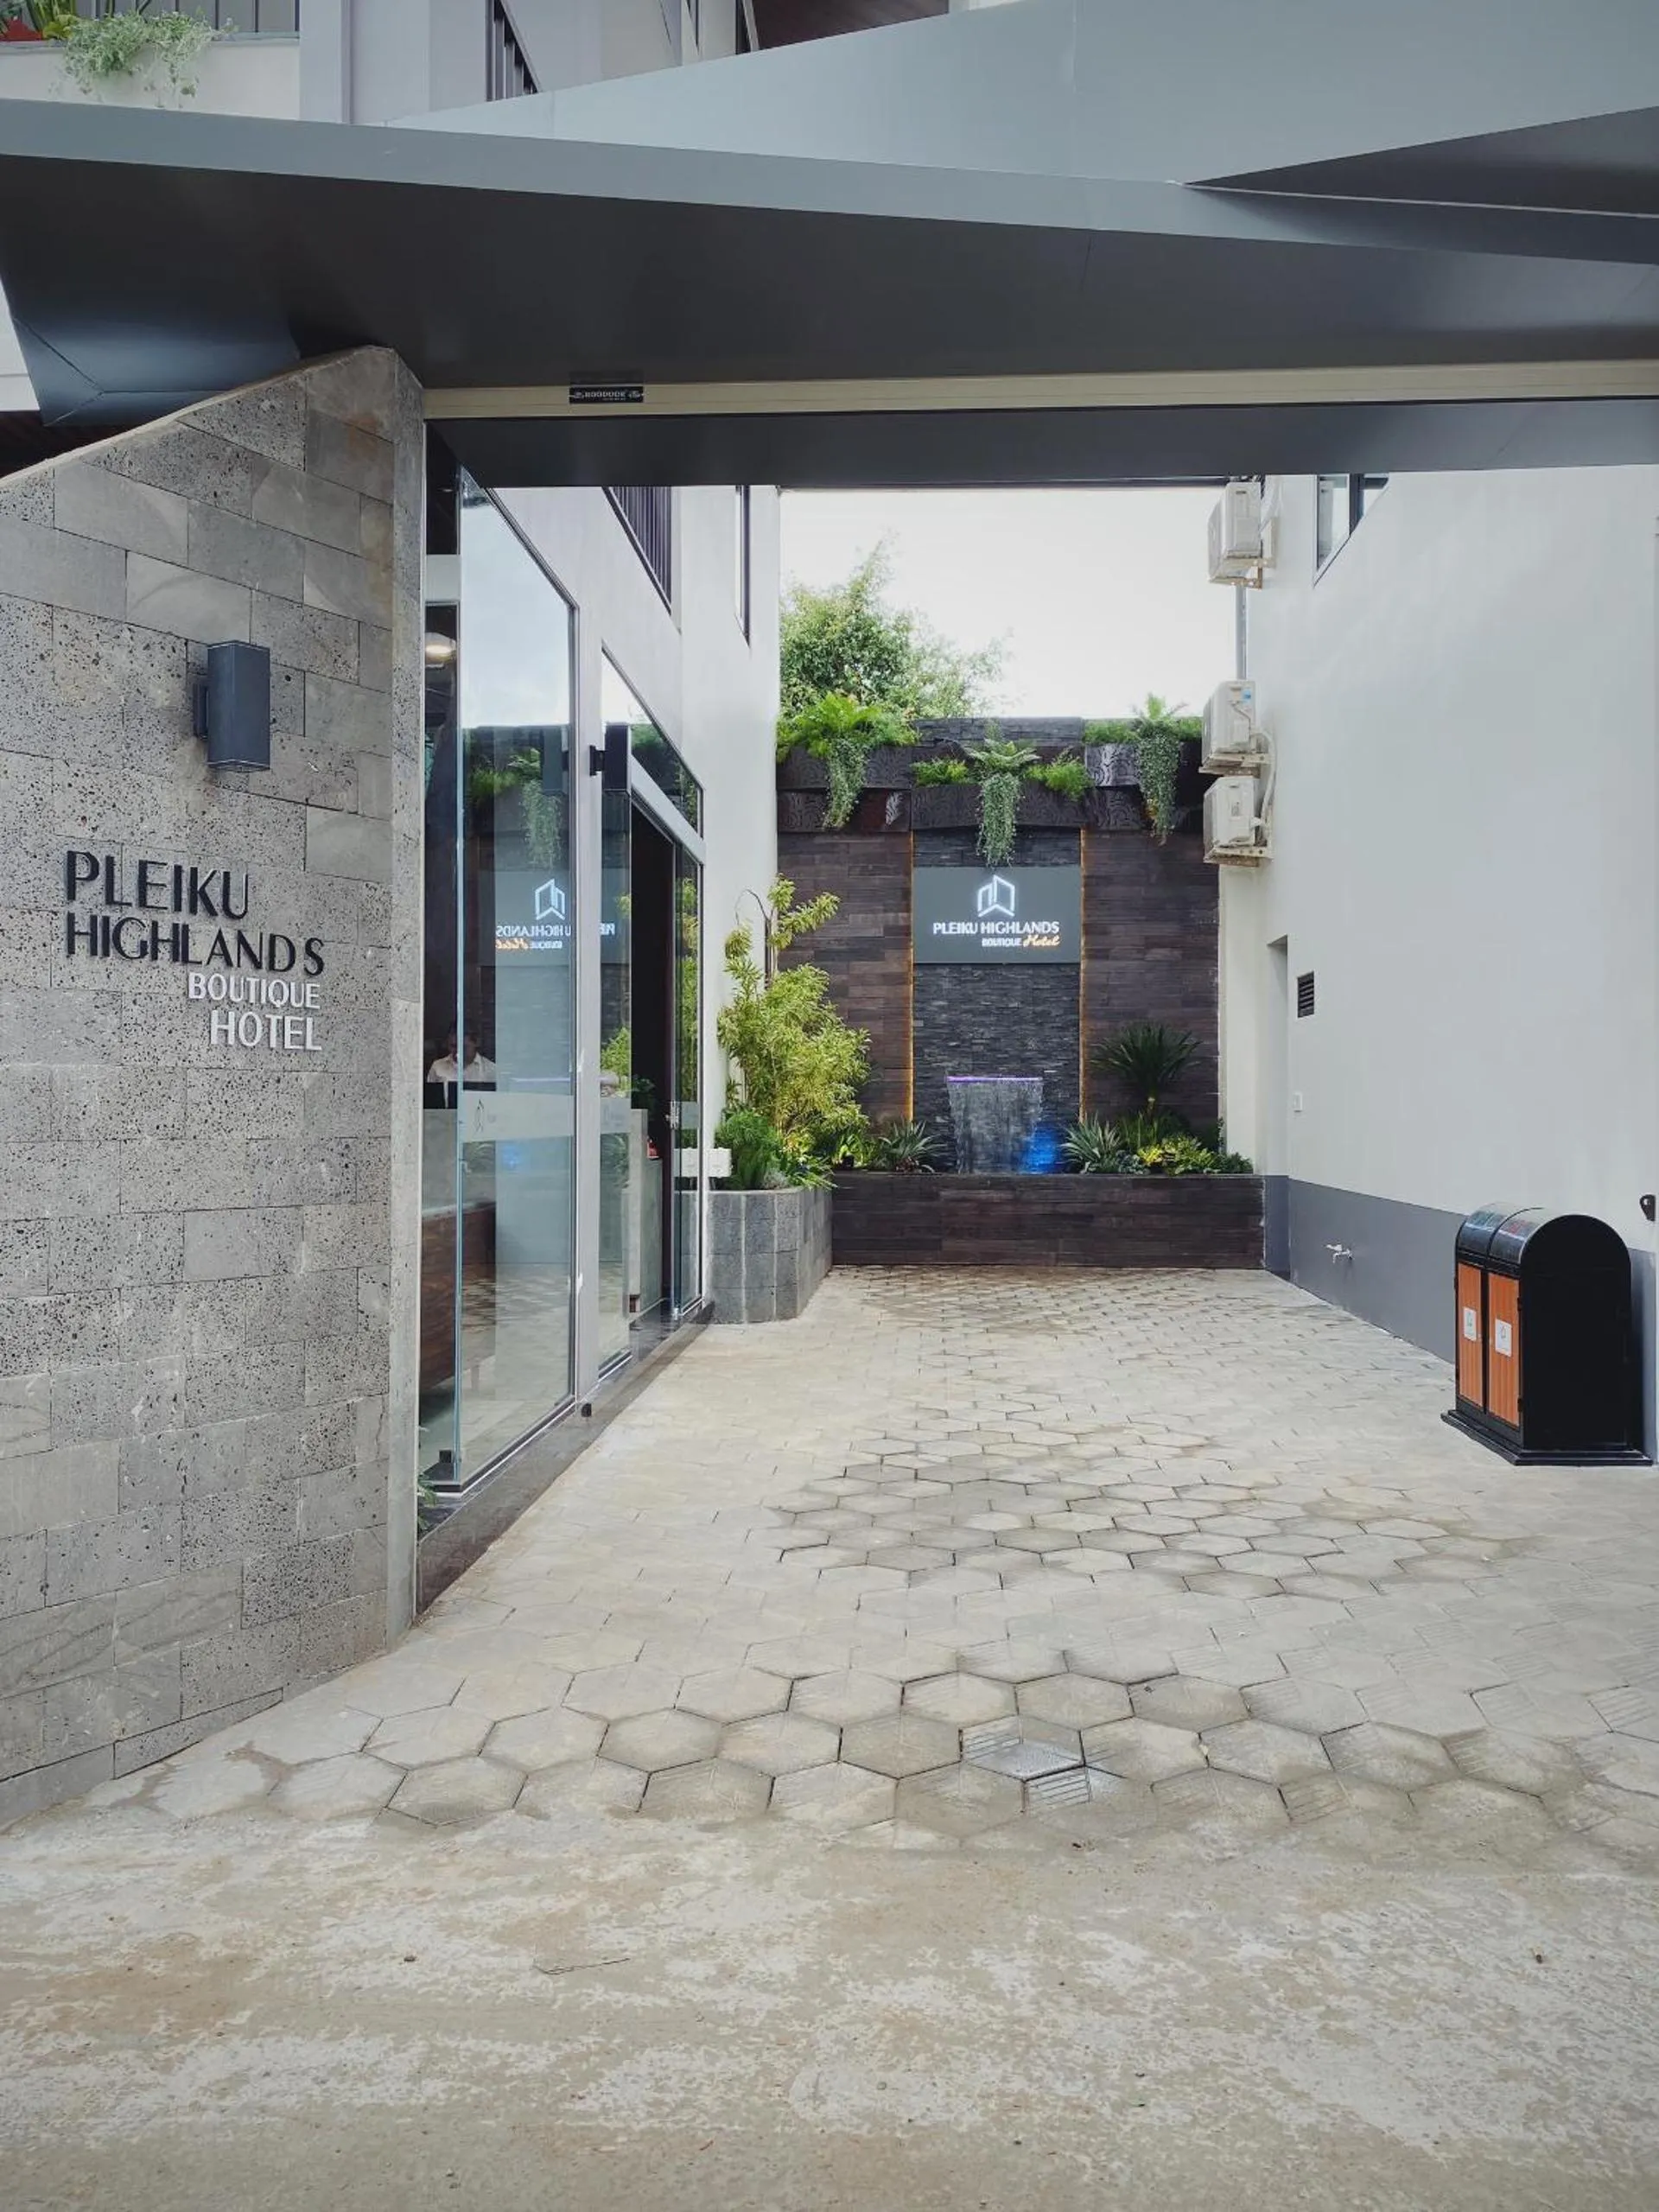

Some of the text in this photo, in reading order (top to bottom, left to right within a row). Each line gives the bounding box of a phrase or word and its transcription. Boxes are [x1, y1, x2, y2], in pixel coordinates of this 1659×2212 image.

[66, 850, 249, 920] PLEIKU
[66, 912, 325, 976] HIGHLANDS
[932, 921, 1060, 935] PLEIKU HIGHLANDS
[982, 934, 1061, 947] BOUTIQUE Hotel
[188, 973, 321, 1009] BOUTIQUE
[210, 1010, 322, 1051] HOTEL
